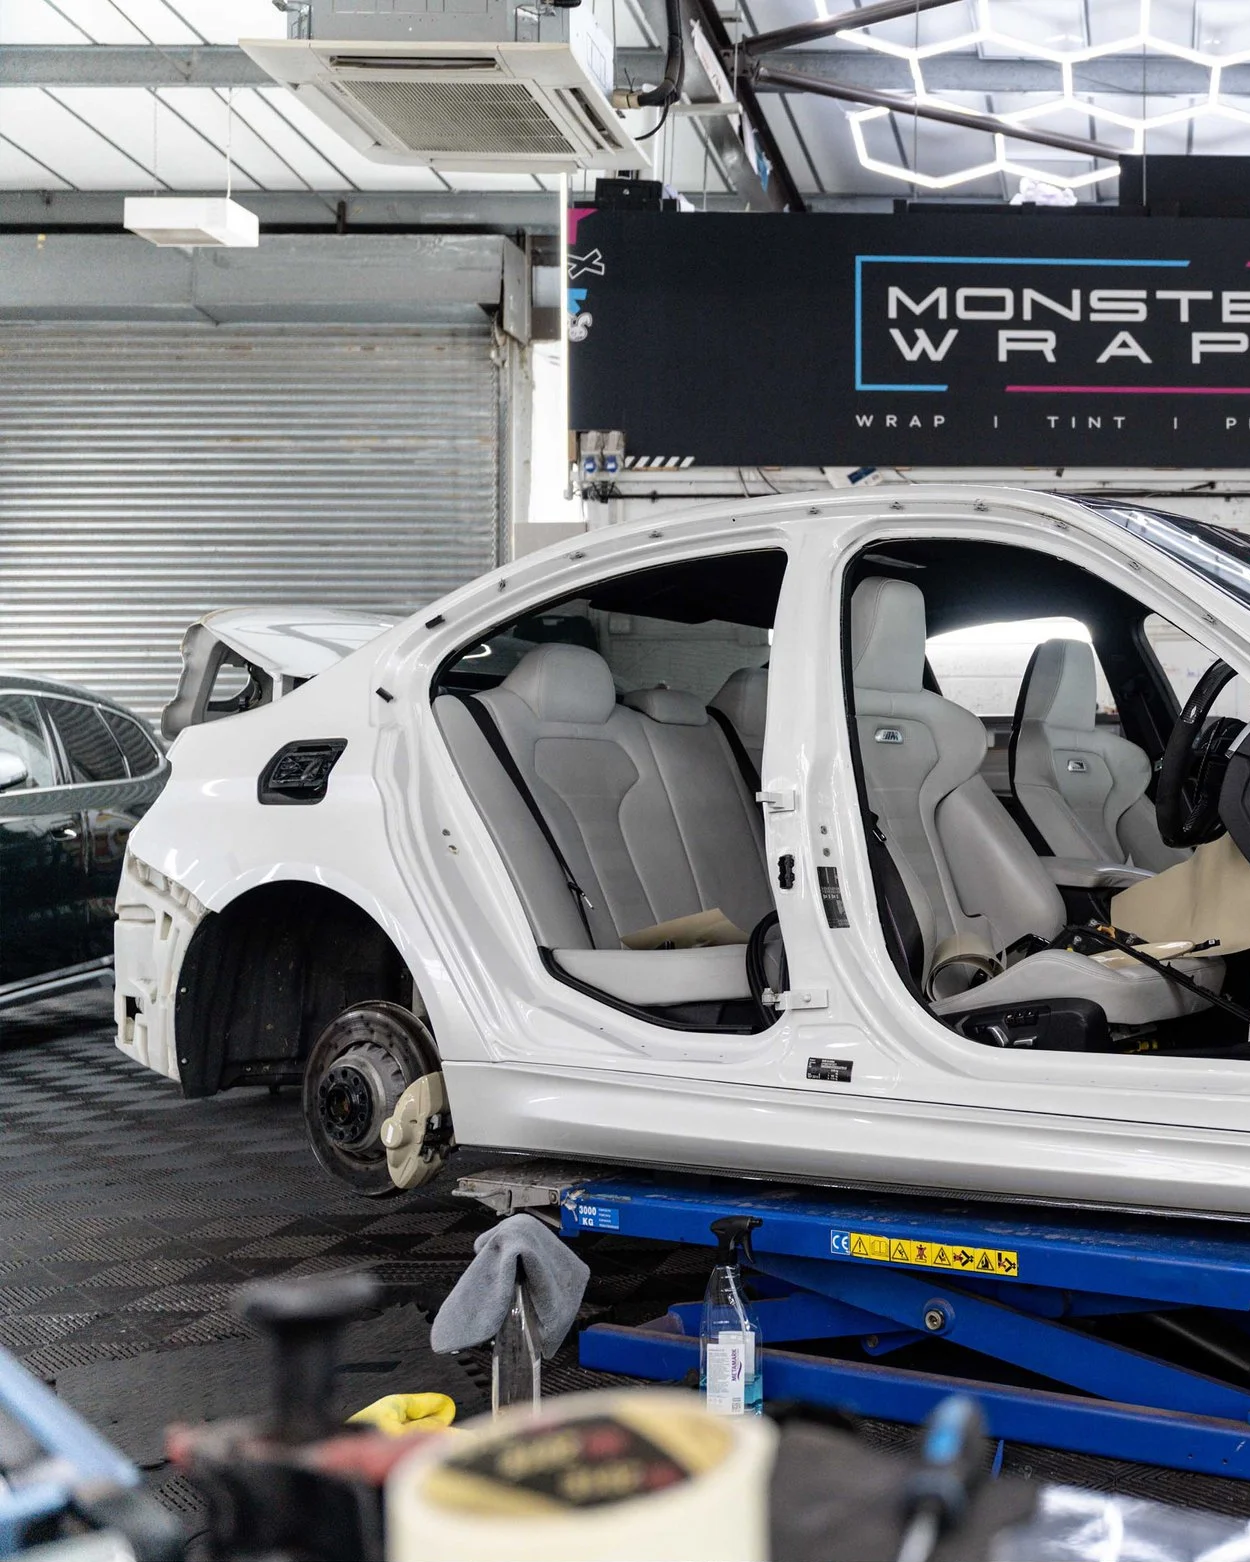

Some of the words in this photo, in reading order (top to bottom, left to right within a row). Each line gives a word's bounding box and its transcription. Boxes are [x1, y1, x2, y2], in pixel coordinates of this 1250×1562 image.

[855, 414, 946, 428] WRAP
[1046, 415, 1127, 429] TINT
[579, 1205, 597, 1216] 3000
[582, 1217, 594, 1226] KG
